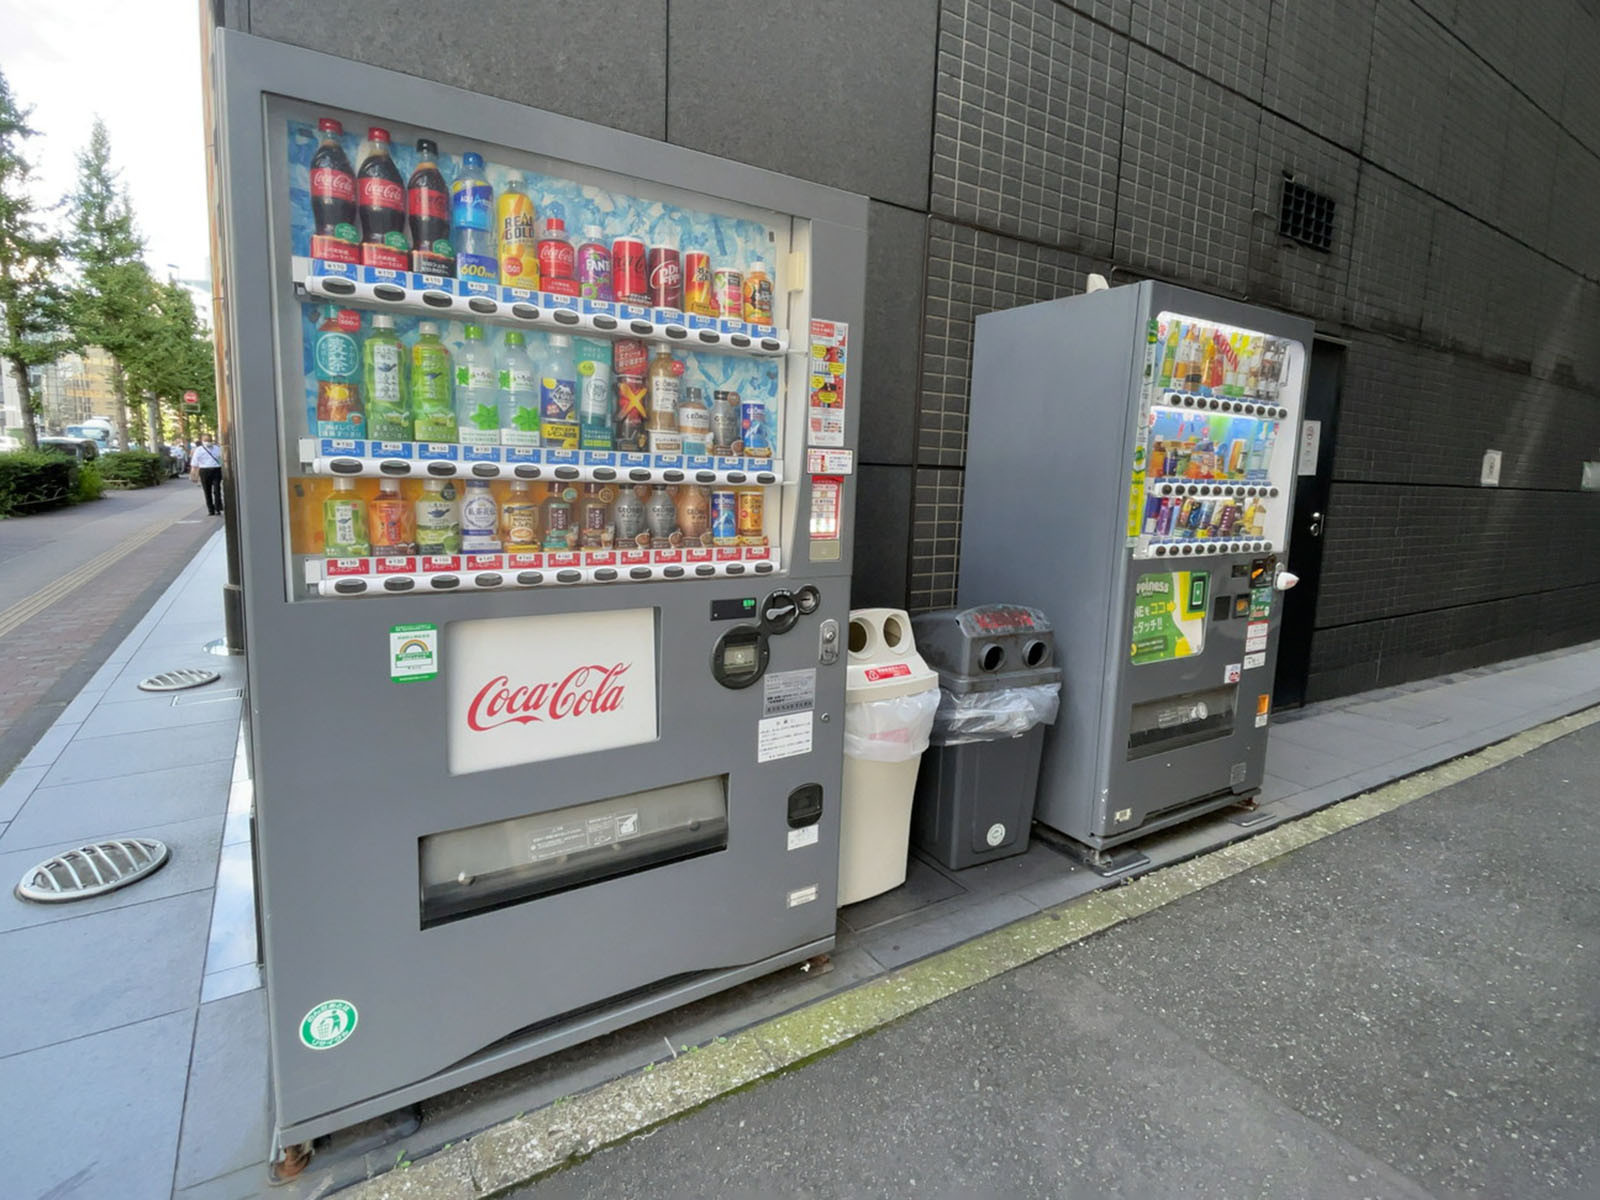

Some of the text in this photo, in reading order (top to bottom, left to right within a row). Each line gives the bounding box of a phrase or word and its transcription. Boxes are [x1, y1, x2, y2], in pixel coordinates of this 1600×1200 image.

[504, 227, 534, 240] GOLD
[586, 258, 610, 271] FANT
[328, 337, 347, 371] 麦茶
[467, 662, 632, 732] Coca-Cola
